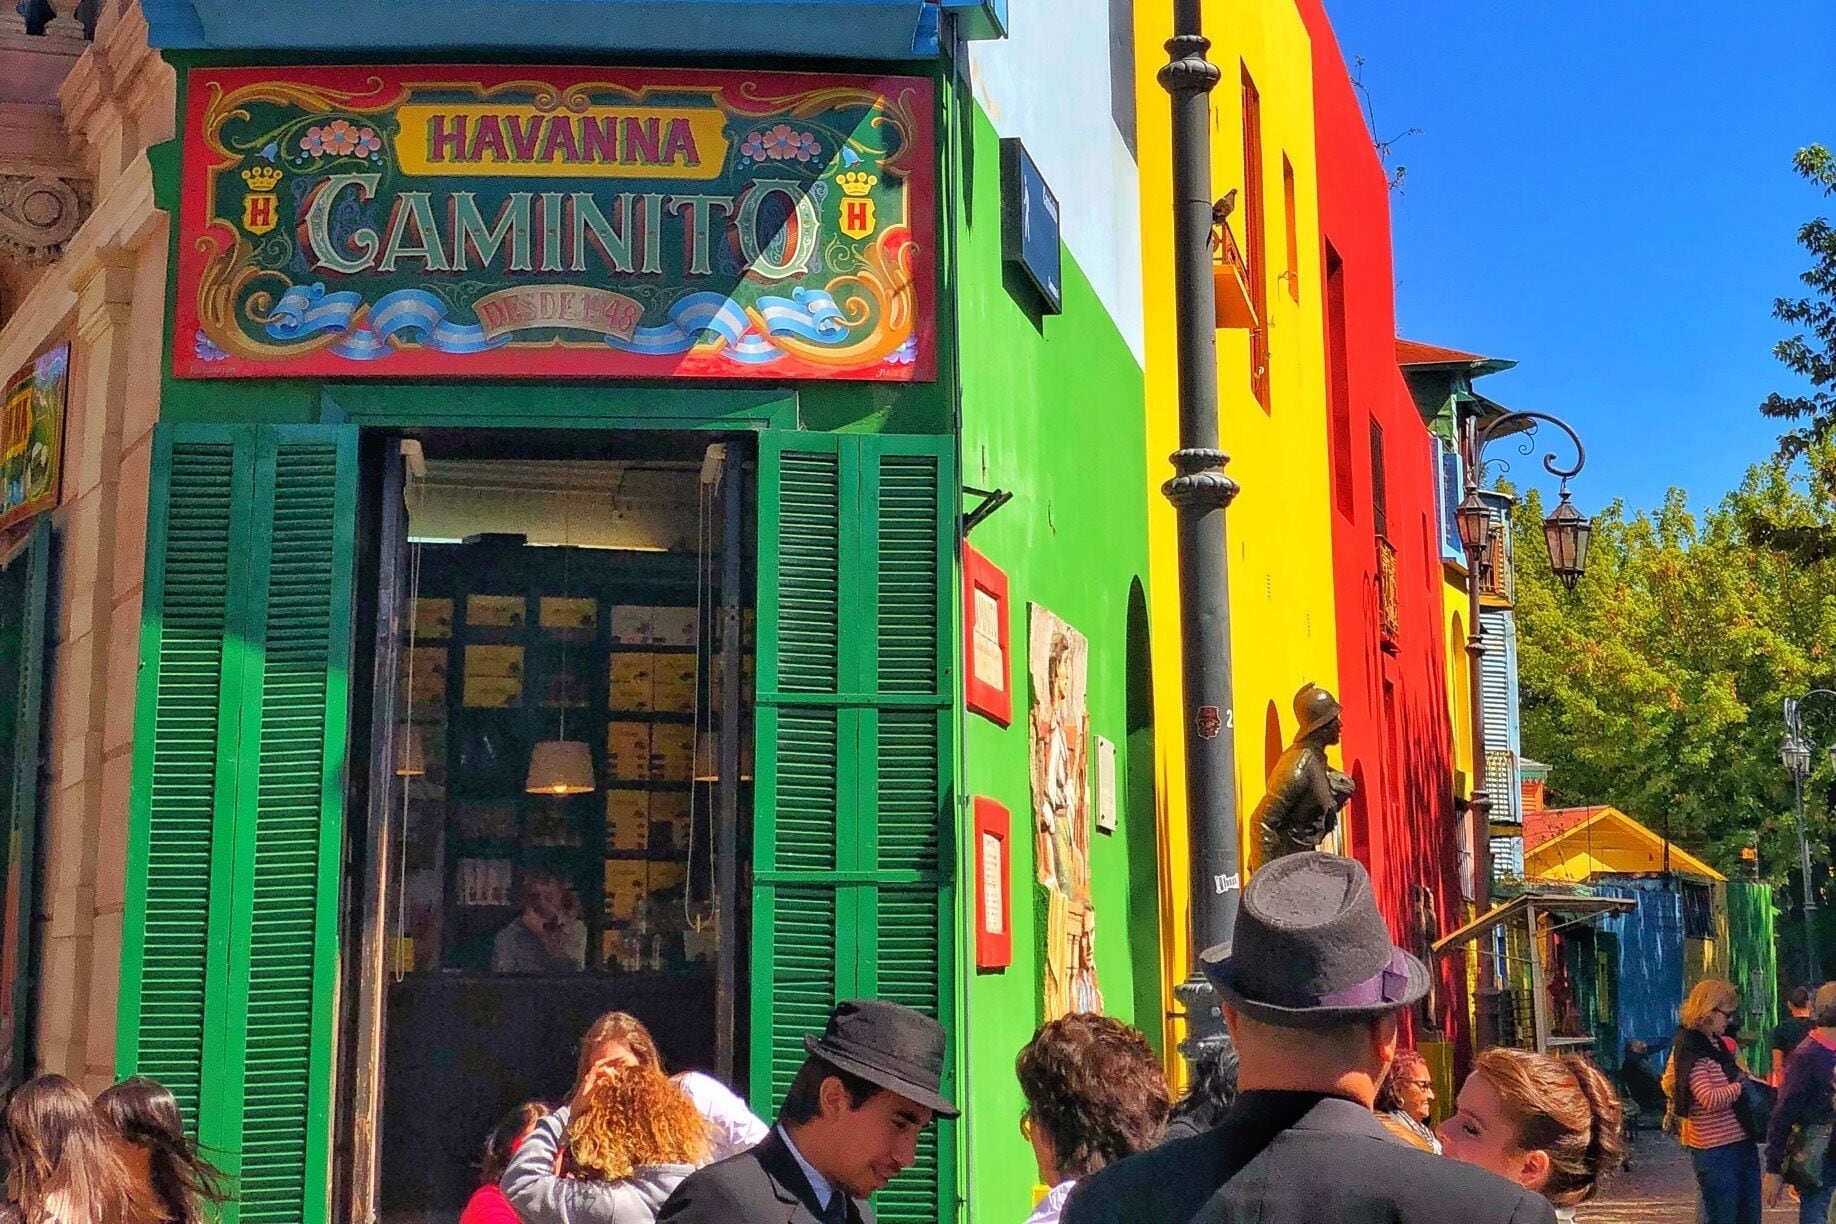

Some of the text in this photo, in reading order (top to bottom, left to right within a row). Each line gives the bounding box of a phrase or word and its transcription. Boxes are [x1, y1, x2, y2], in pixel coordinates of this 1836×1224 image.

[426, 115, 701, 167] HAVANNA
[250, 198, 270, 226] H
[299, 173, 820, 278] CAMINITO
[847, 203, 867, 231] H
[481, 291, 577, 329] DESDE
[1226, 709, 1233, 728] 2
